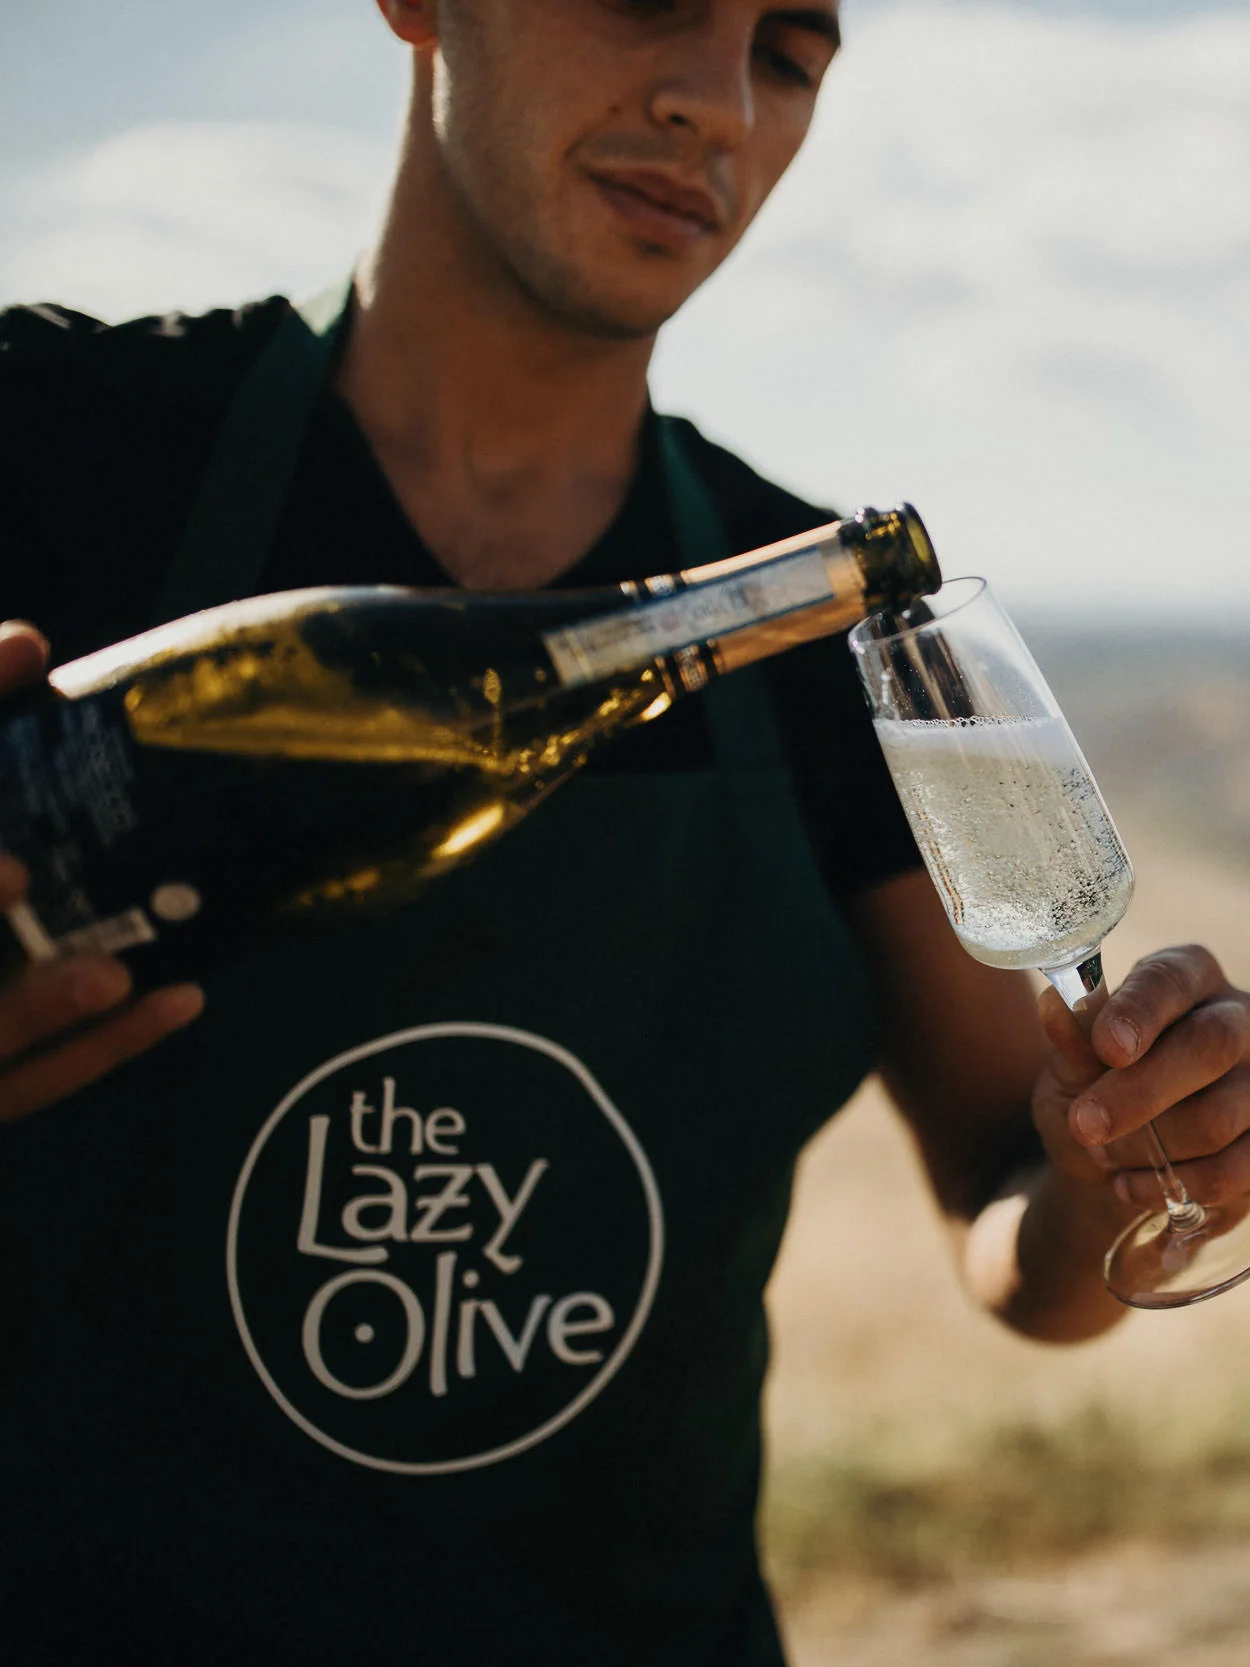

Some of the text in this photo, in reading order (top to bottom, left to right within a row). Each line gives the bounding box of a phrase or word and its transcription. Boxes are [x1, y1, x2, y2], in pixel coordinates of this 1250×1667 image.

[350, 1077, 466, 1154] the
[297, 1115, 548, 1273] Lazy
[302, 1251, 614, 1399] Olive
